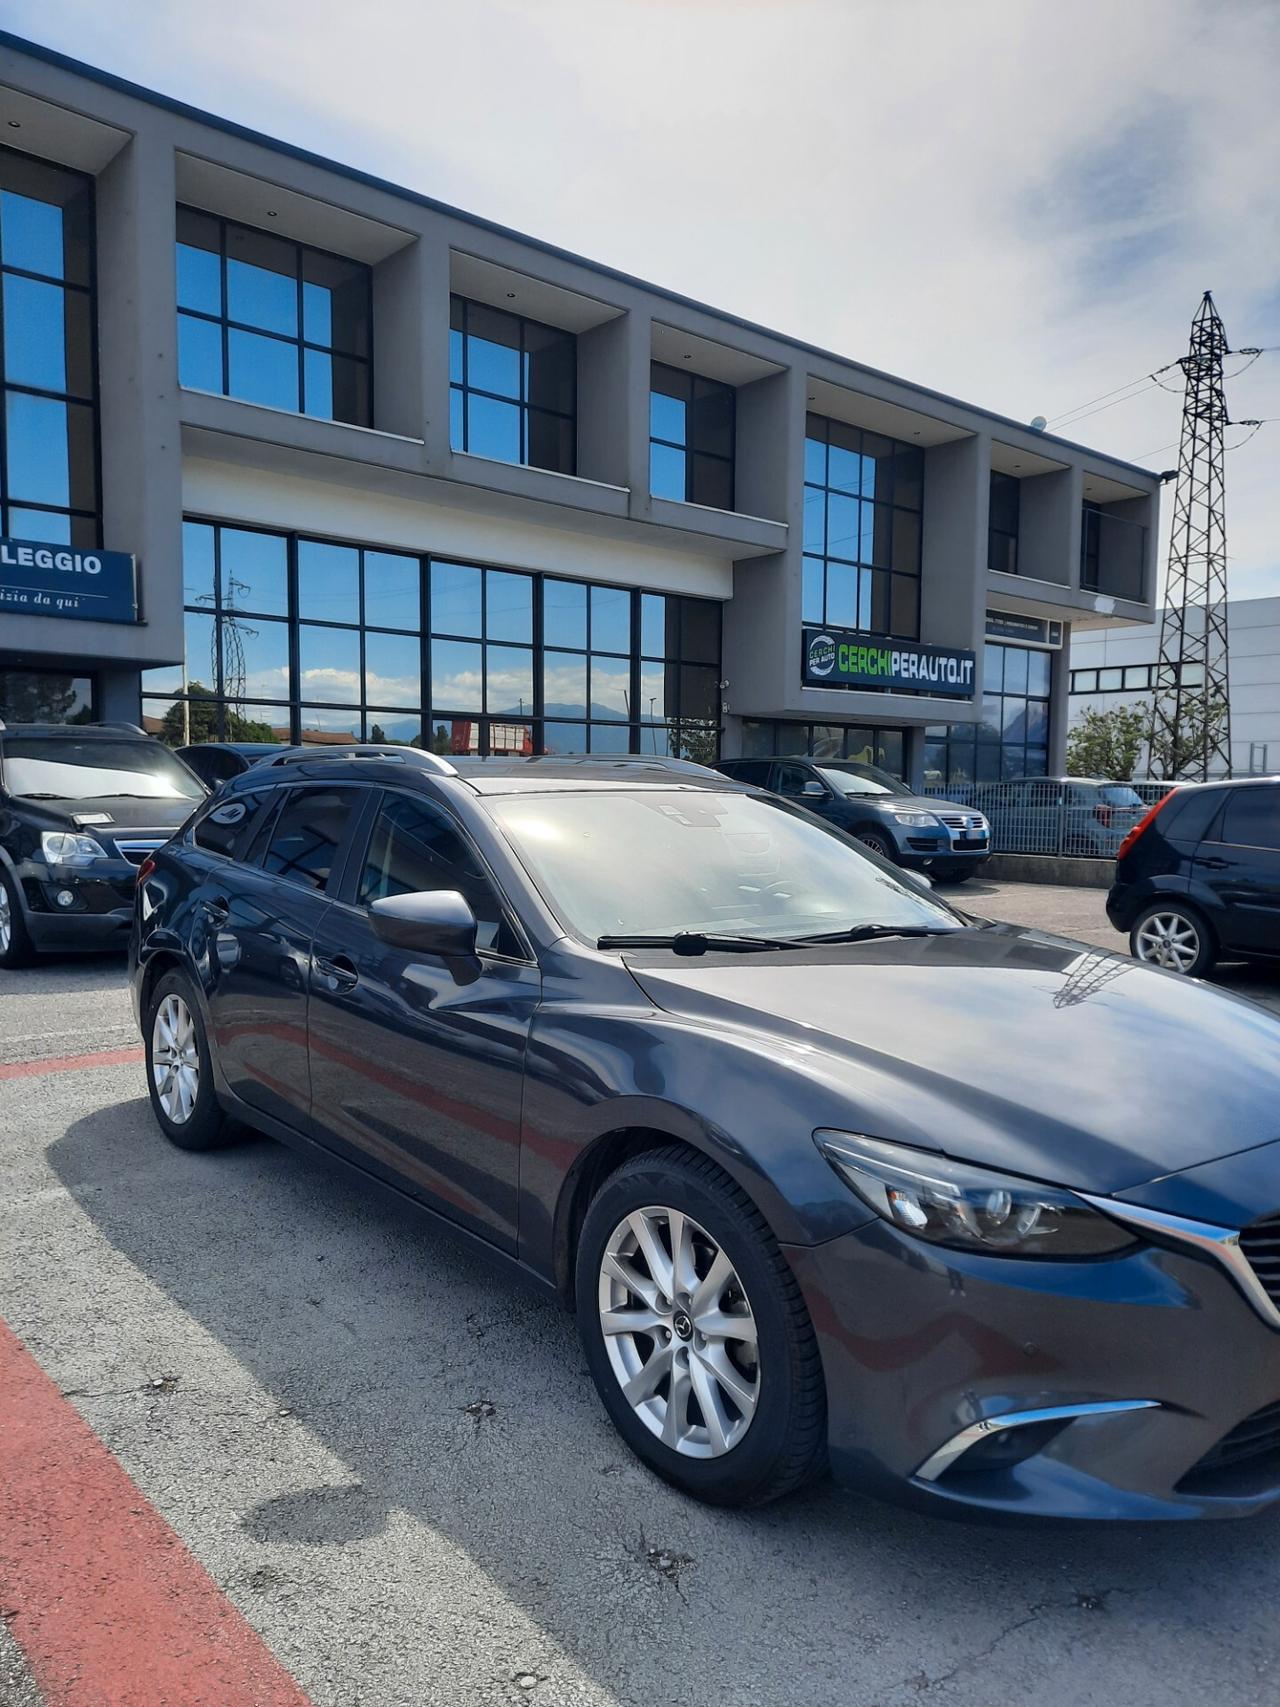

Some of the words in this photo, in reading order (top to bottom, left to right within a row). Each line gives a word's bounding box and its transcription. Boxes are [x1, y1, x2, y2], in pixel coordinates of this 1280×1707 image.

[0, 545, 102, 575] LEGGIO
[33, 593, 51, 605] da
[56, 597, 79, 609] qui
[809, 645, 835, 658] CERCHI
[809, 657, 820, 667] PER
[821, 652, 835, 662] AUTO
[838, 644, 973, 684] CERCHIPERAUTO.IT
